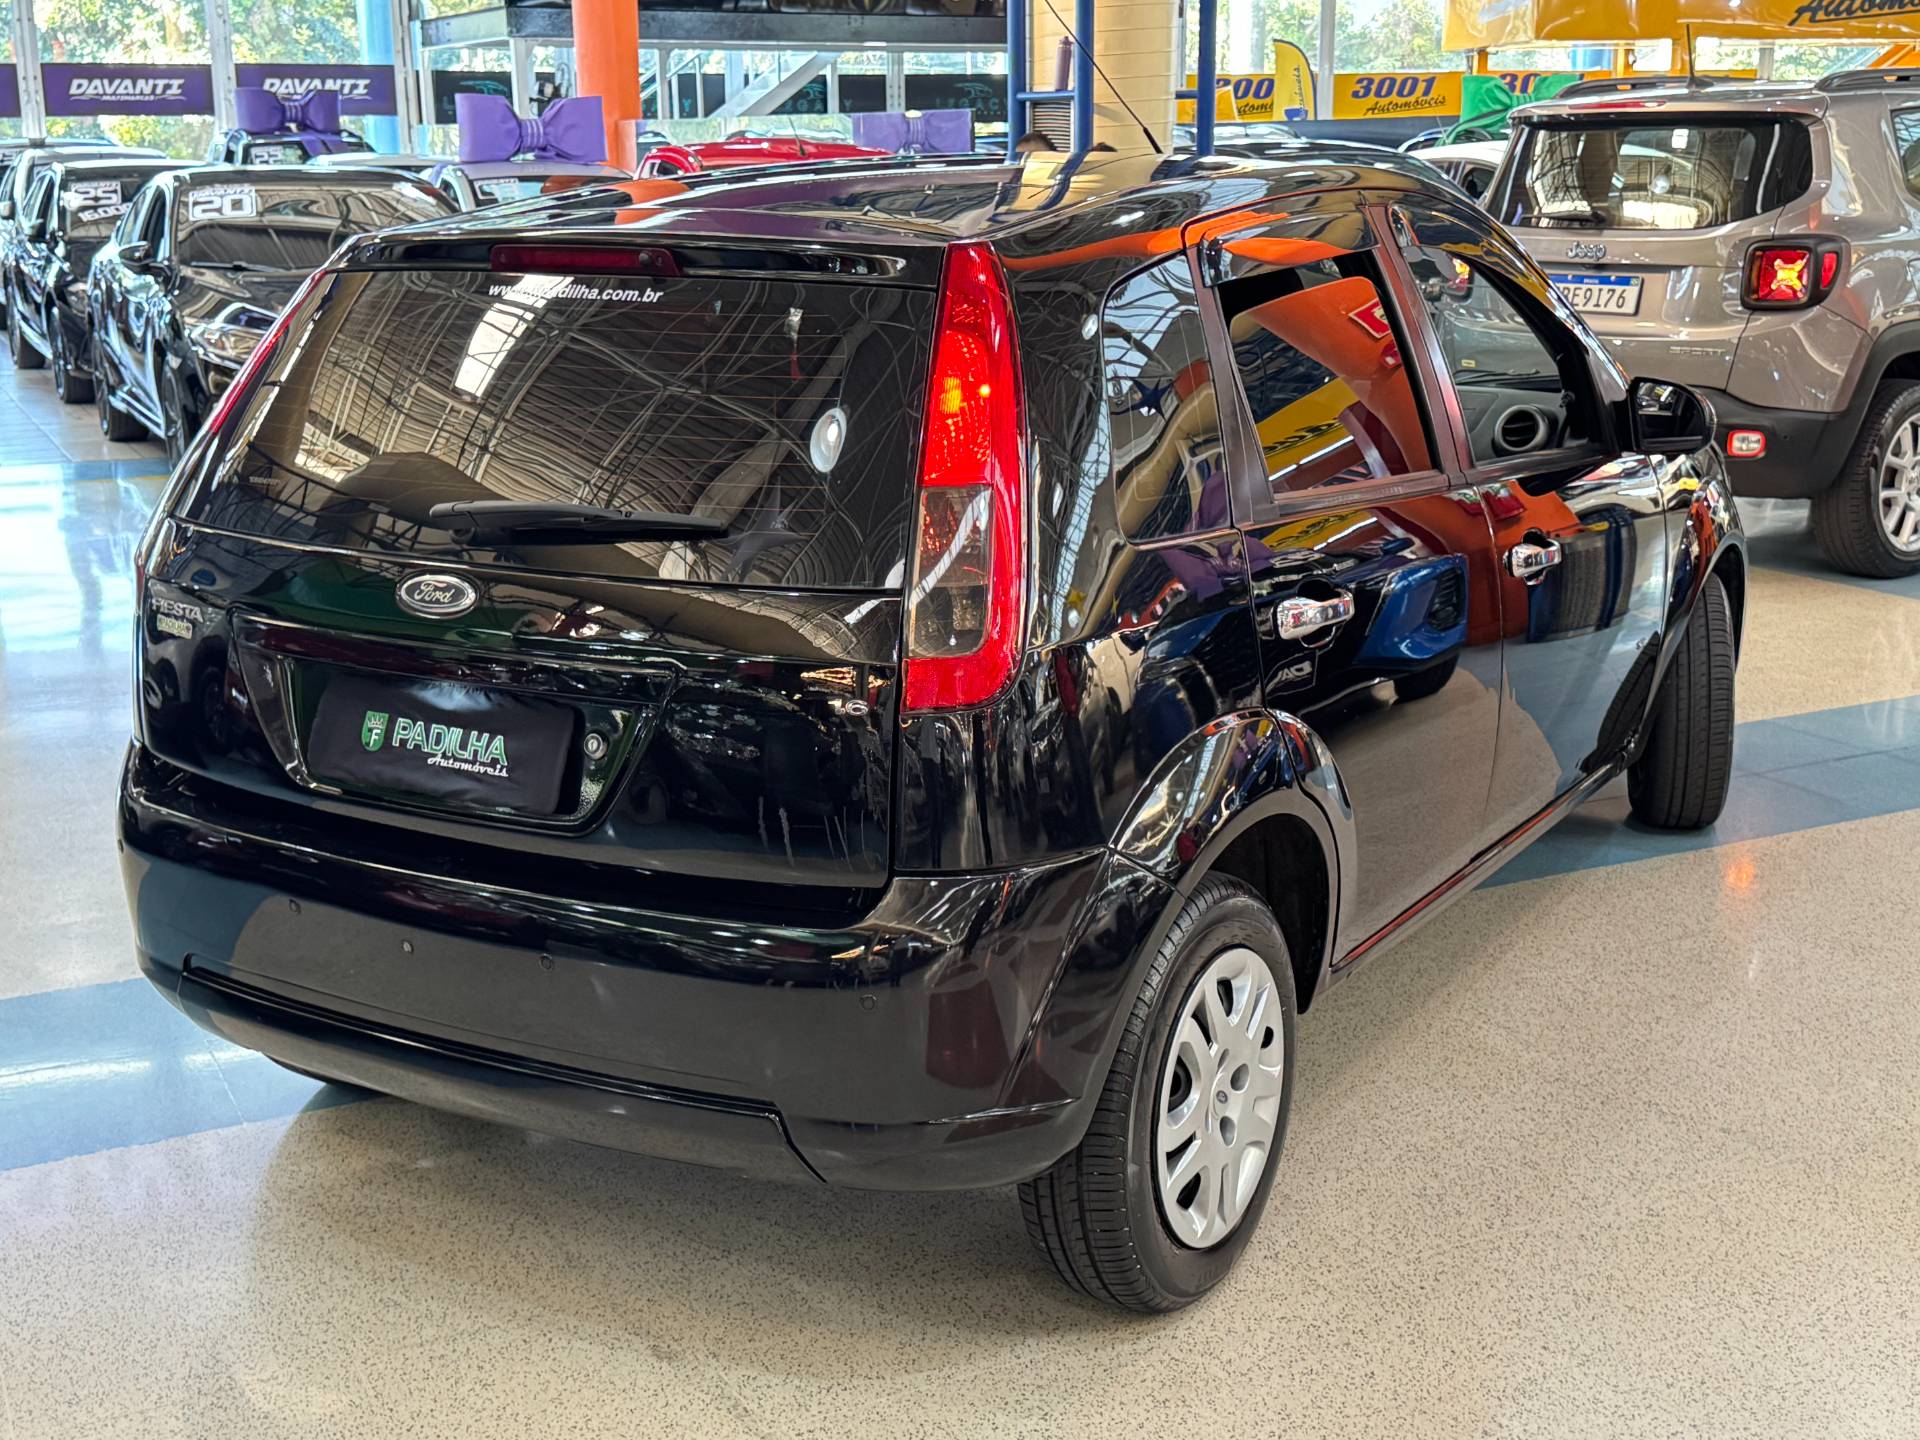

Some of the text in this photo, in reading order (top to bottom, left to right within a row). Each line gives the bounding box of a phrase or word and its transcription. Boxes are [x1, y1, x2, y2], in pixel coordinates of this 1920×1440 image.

[69, 78, 185, 95] DAVANTI
[1351, 76, 1437, 98] 3001
[1363, 94, 1447, 116] Automóveis
[72, 188, 118, 206] 25
[193, 196, 252, 218] 20
[1566, 241, 1607, 262] Jeep
[414, 580, 455, 604] Ford
[151, 598, 204, 624] FIESTA
[392, 717, 508, 766] PADILHA
[427, 753, 509, 777] Automóveis
